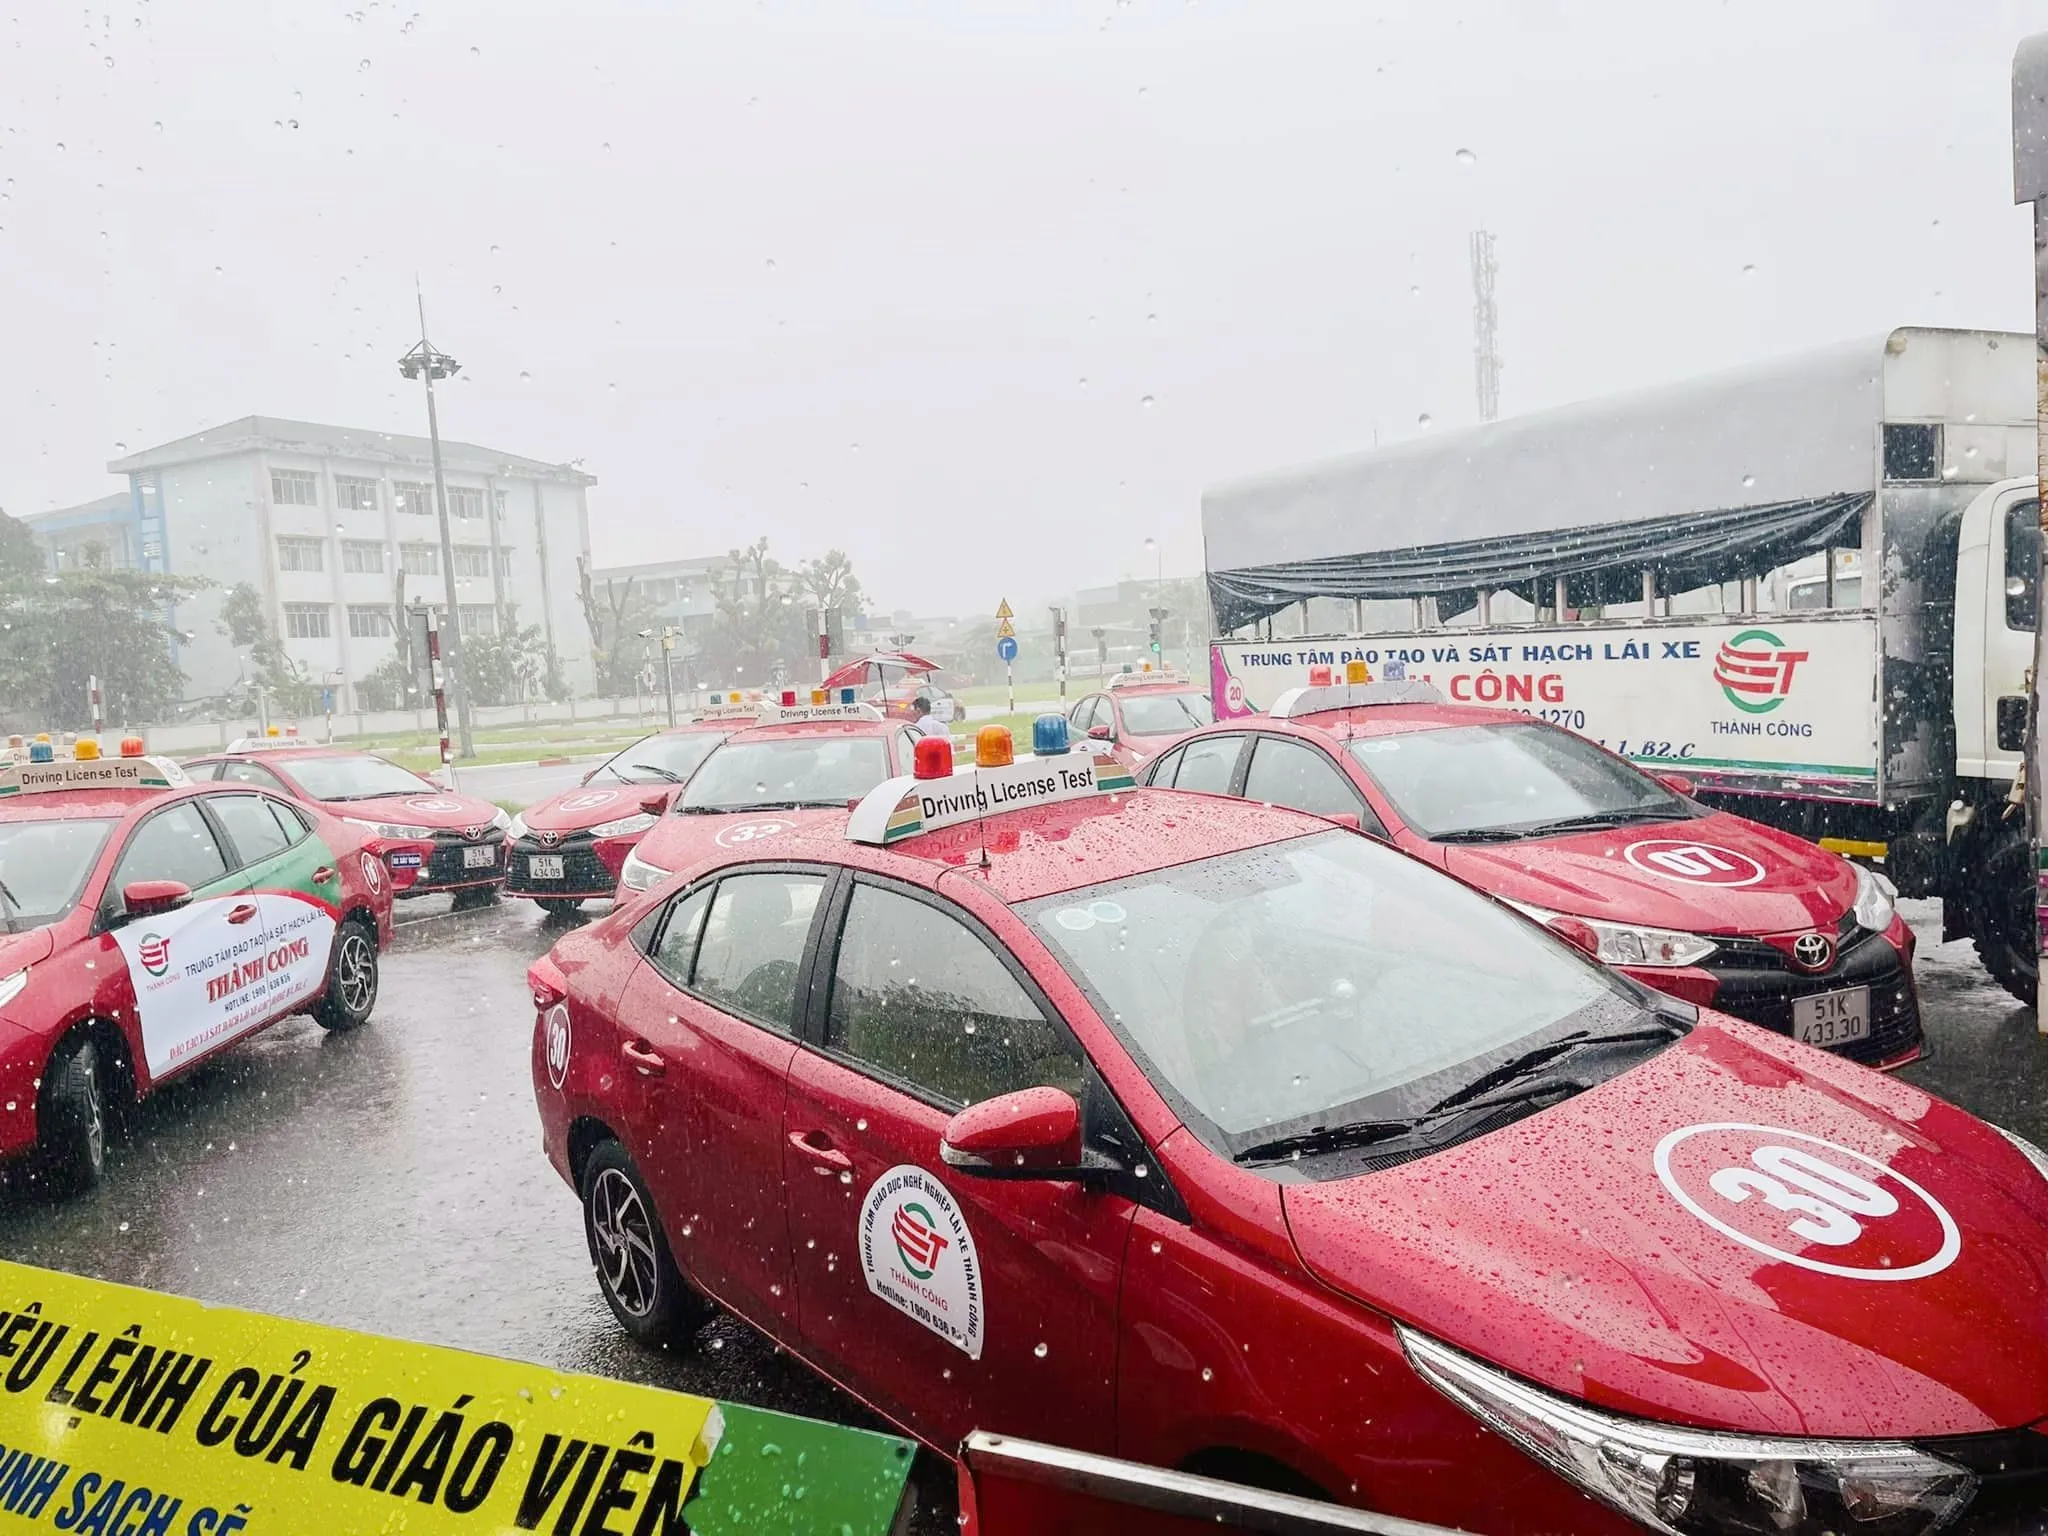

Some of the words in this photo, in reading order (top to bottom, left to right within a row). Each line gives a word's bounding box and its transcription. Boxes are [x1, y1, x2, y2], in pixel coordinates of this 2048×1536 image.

[1241, 653, 1292, 666] TRUNG
[1297, 650, 1334, 665] TÂM
[1431, 644, 1460, 662] VÀ
[1469, 643, 1512, 662] SÁT
[1523, 644, 1592, 664] HẠCH
[1604, 639, 1649, 660] LÁI
[1662, 641, 1700, 659] XE
[1230, 686, 1241, 700] 20
[1450, 668, 1564, 702] CÔNG
[780, 709, 808, 719] Driving
[811, 707, 841, 717] License
[844, 705, 860, 714] Test
[1710, 719, 1761, 735] THÀNH
[1766, 720, 1813, 737] CÔNG
[22, 771, 62, 785] Driving
[66, 769, 112, 782] License
[115, 766, 138, 779] Test
[922, 788, 988, 819] Driving
[991, 775, 1056, 804] License
[1059, 766, 1094, 791] Test
[1647, 846, 1735, 876] 07
[185, 956, 214, 976] TRUNG
[1814, 996, 1847, 1019] 51K
[1802, 1015, 1861, 1045] 433.30
[550, 1022, 566, 1071] 30
[1709, 1145, 1899, 1246] 30
[958, 1236, 968, 1253] XE
[922, 1287, 948, 1311] CÔNG
[909, 1301, 931, 1322] 1900
[45, 1324, 212, 1434] LỆNH
[196, 1350, 337, 1471] CỦA
[331, 1394, 514, 1514] GIÁO
